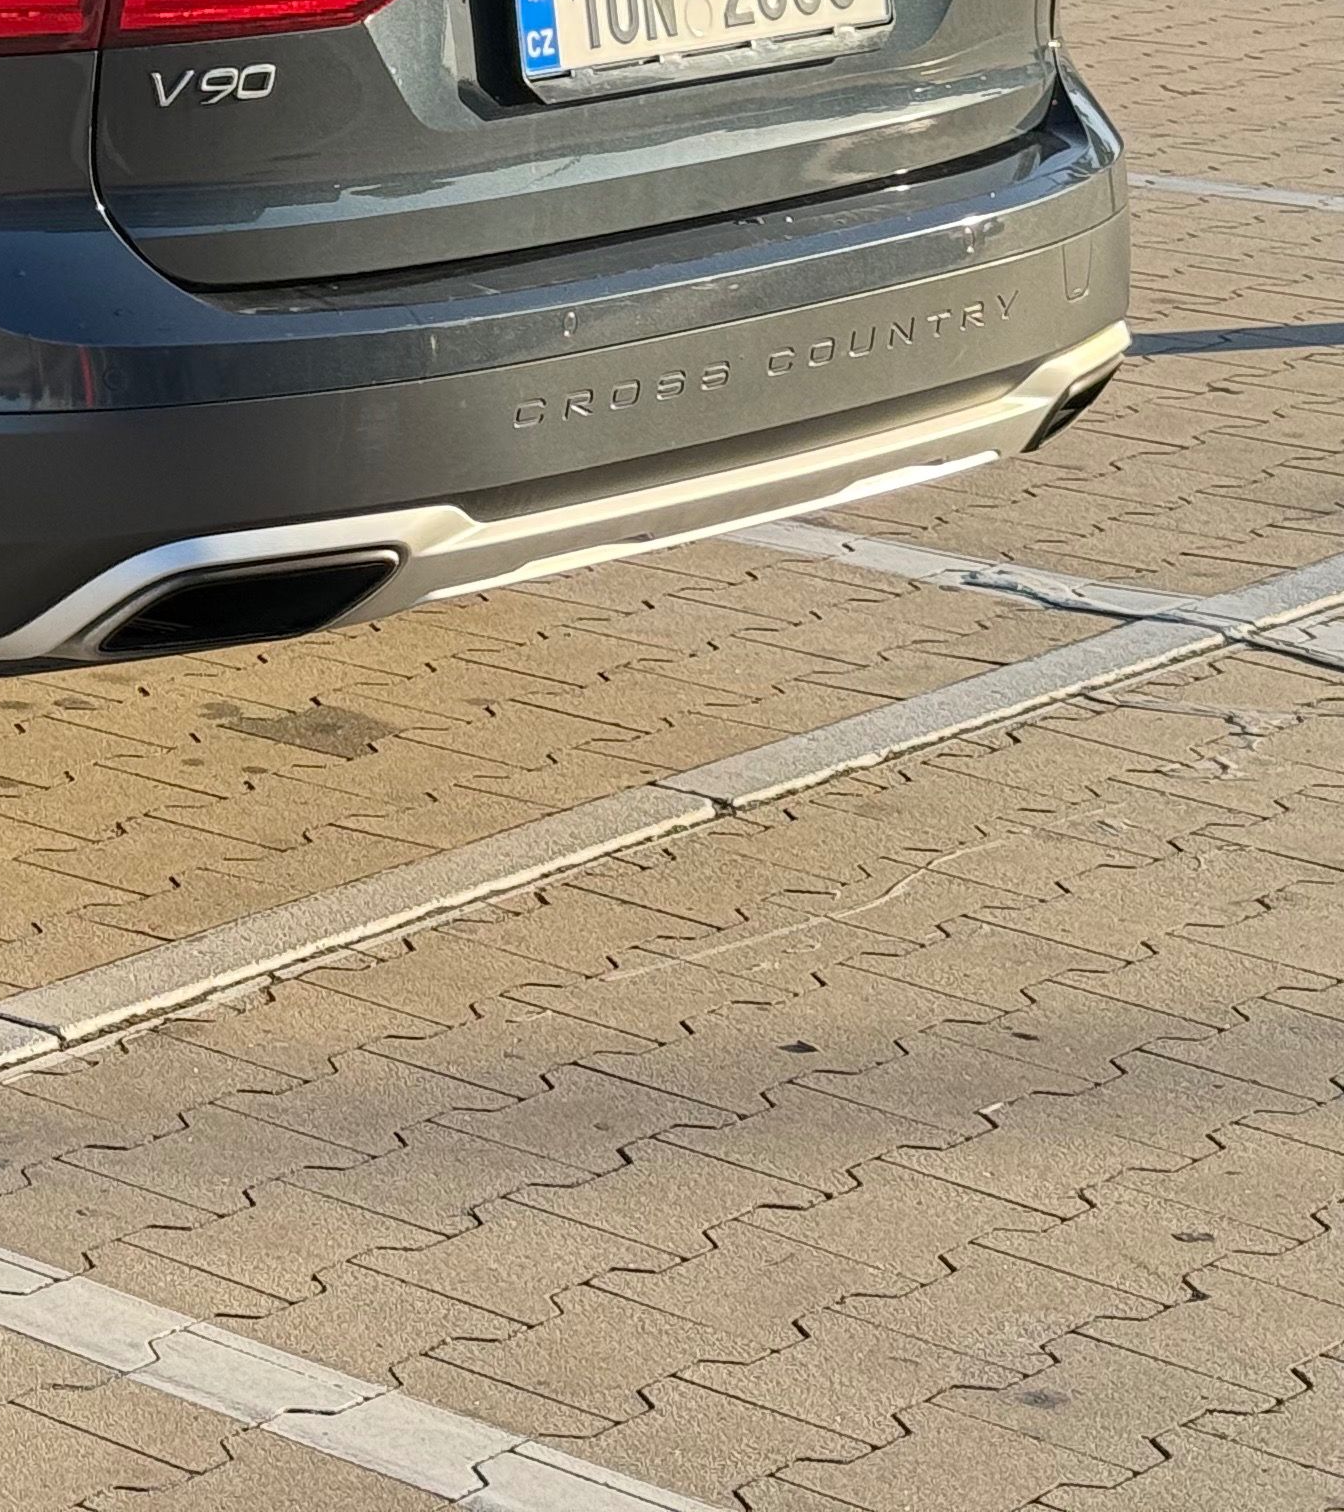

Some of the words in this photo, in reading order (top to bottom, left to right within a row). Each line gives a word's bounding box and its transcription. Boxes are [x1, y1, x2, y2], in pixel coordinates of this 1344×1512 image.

[525, 27, 557, 60] CZ
[150, 63, 277, 108] V90
[512, 360, 732, 429] CROSS
[765, 289, 1021, 377] COUNTRY
